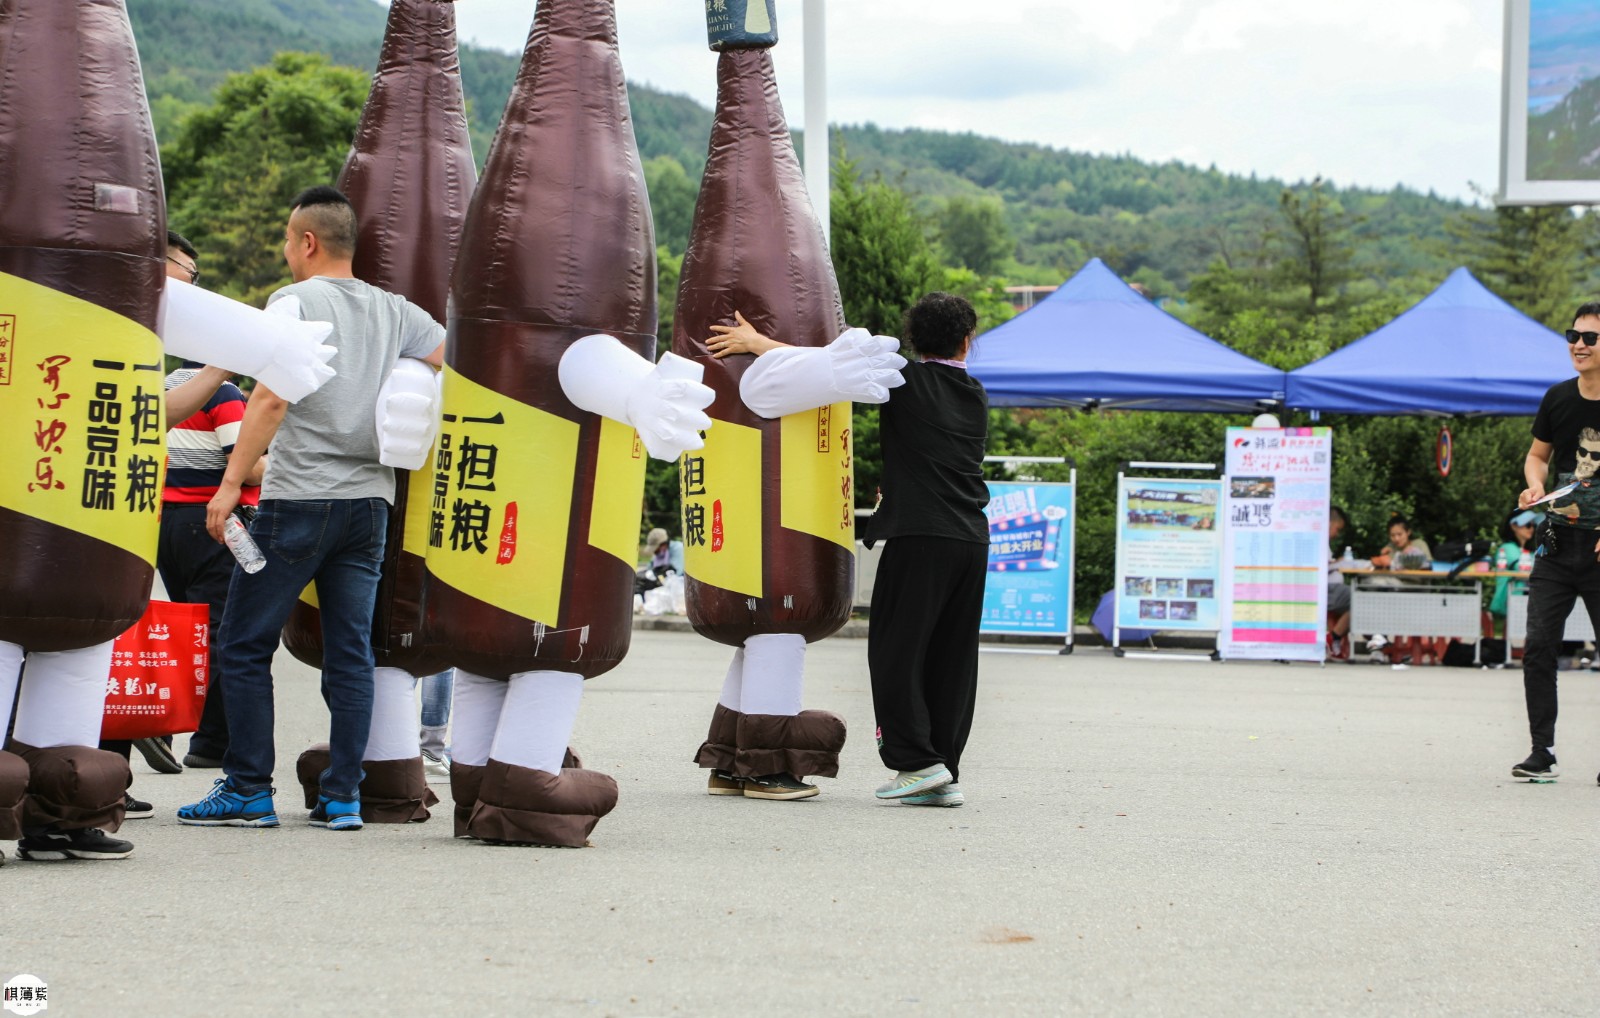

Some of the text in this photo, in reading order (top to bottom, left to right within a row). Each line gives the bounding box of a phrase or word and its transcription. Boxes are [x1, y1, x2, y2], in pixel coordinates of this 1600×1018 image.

[81, 358, 126, 511] 一品京味
[124, 359, 162, 515] 一担粮
[429, 413, 457, 548] 一品京味
[449, 412, 505, 555] 一担粮
[683, 430, 707, 548] 担粮
